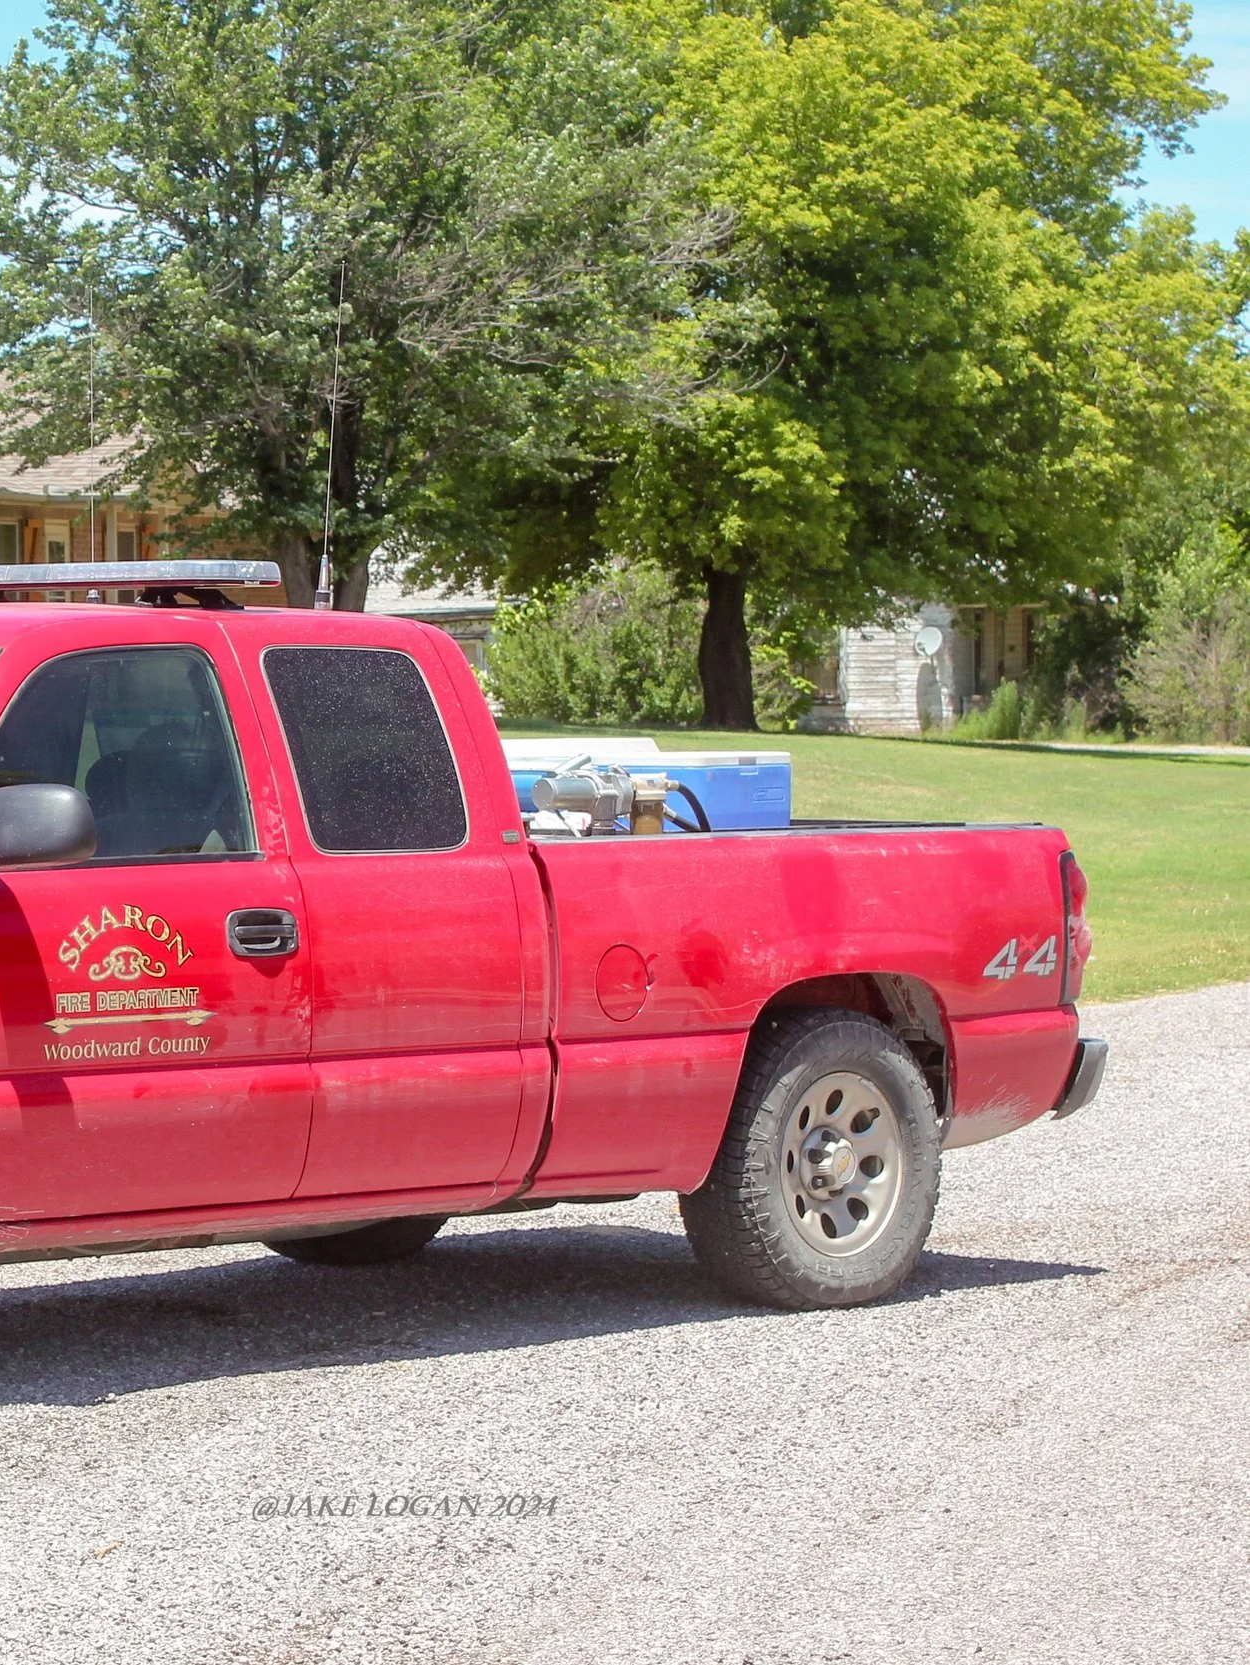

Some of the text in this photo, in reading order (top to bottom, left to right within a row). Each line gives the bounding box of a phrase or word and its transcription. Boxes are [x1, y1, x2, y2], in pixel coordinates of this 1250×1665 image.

[57, 903, 193, 972] SHARON
[56, 986, 199, 1014] FIRE DEPARTMENT
[44, 1036, 211, 1061] Woodward County
